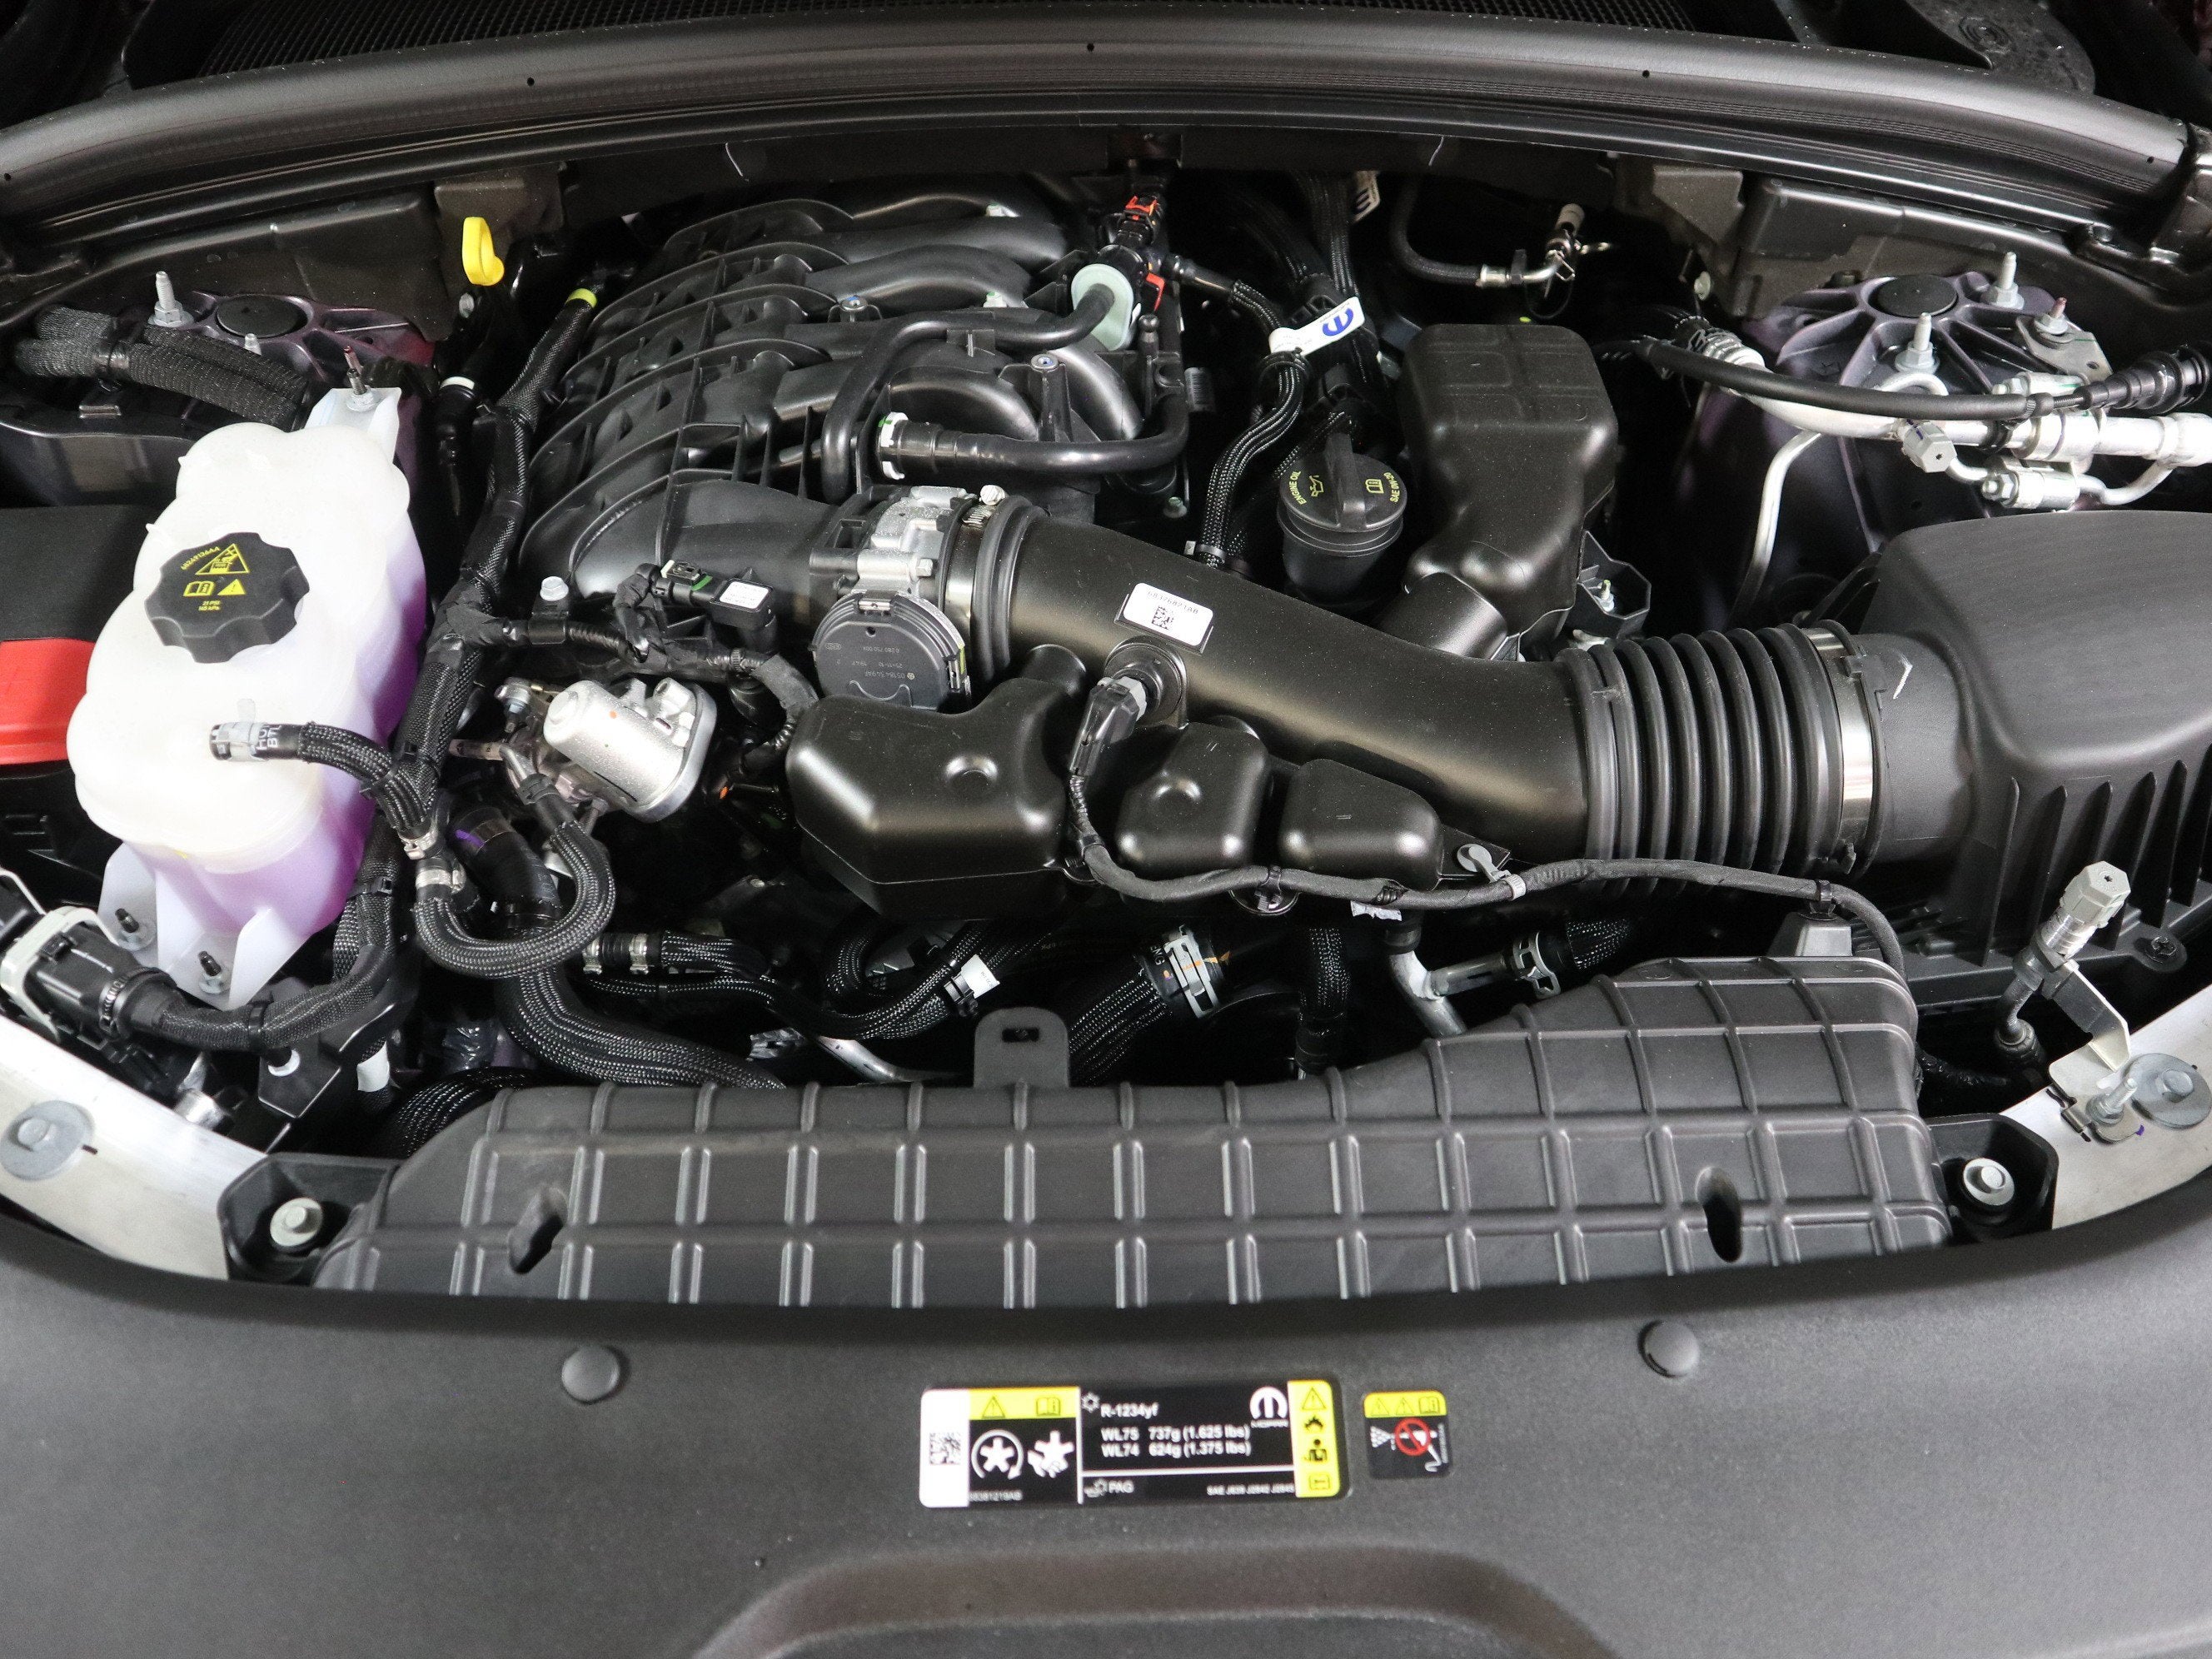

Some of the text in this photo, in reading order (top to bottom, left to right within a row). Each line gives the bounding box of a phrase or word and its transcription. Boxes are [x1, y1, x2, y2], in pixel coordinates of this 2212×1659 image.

[1288, 471, 1308, 505] ENGINE OIL
[1389, 489, 1401, 503] SAE
[1100, 1402, 1159, 1419] R-1234yf
[1100, 1423, 1250, 1442] WL75 737g (1.625 lbs)
[1101, 1440, 1252, 1459] WL74 624g (1.375 lbs)
[1108, 1480, 1134, 1493] PAG
